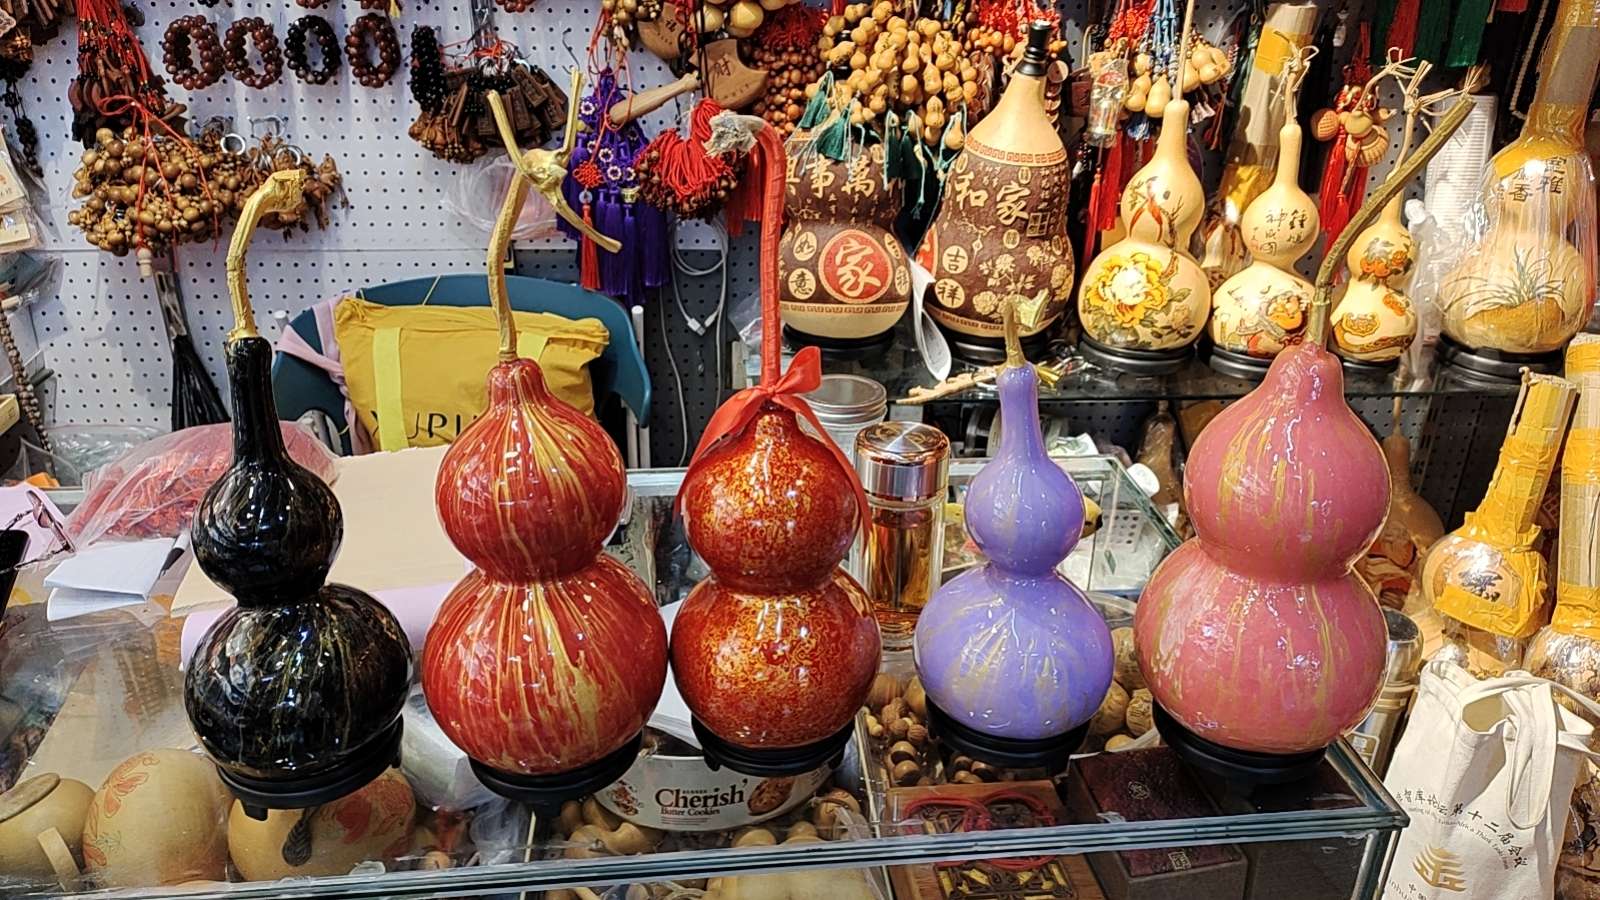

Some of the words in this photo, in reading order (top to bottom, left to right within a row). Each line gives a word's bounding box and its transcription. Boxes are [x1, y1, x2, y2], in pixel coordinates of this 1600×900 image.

[835, 237, 882, 298] 家
[660, 807, 685, 816] Butter
[687, 807, 721, 816] Cookies
